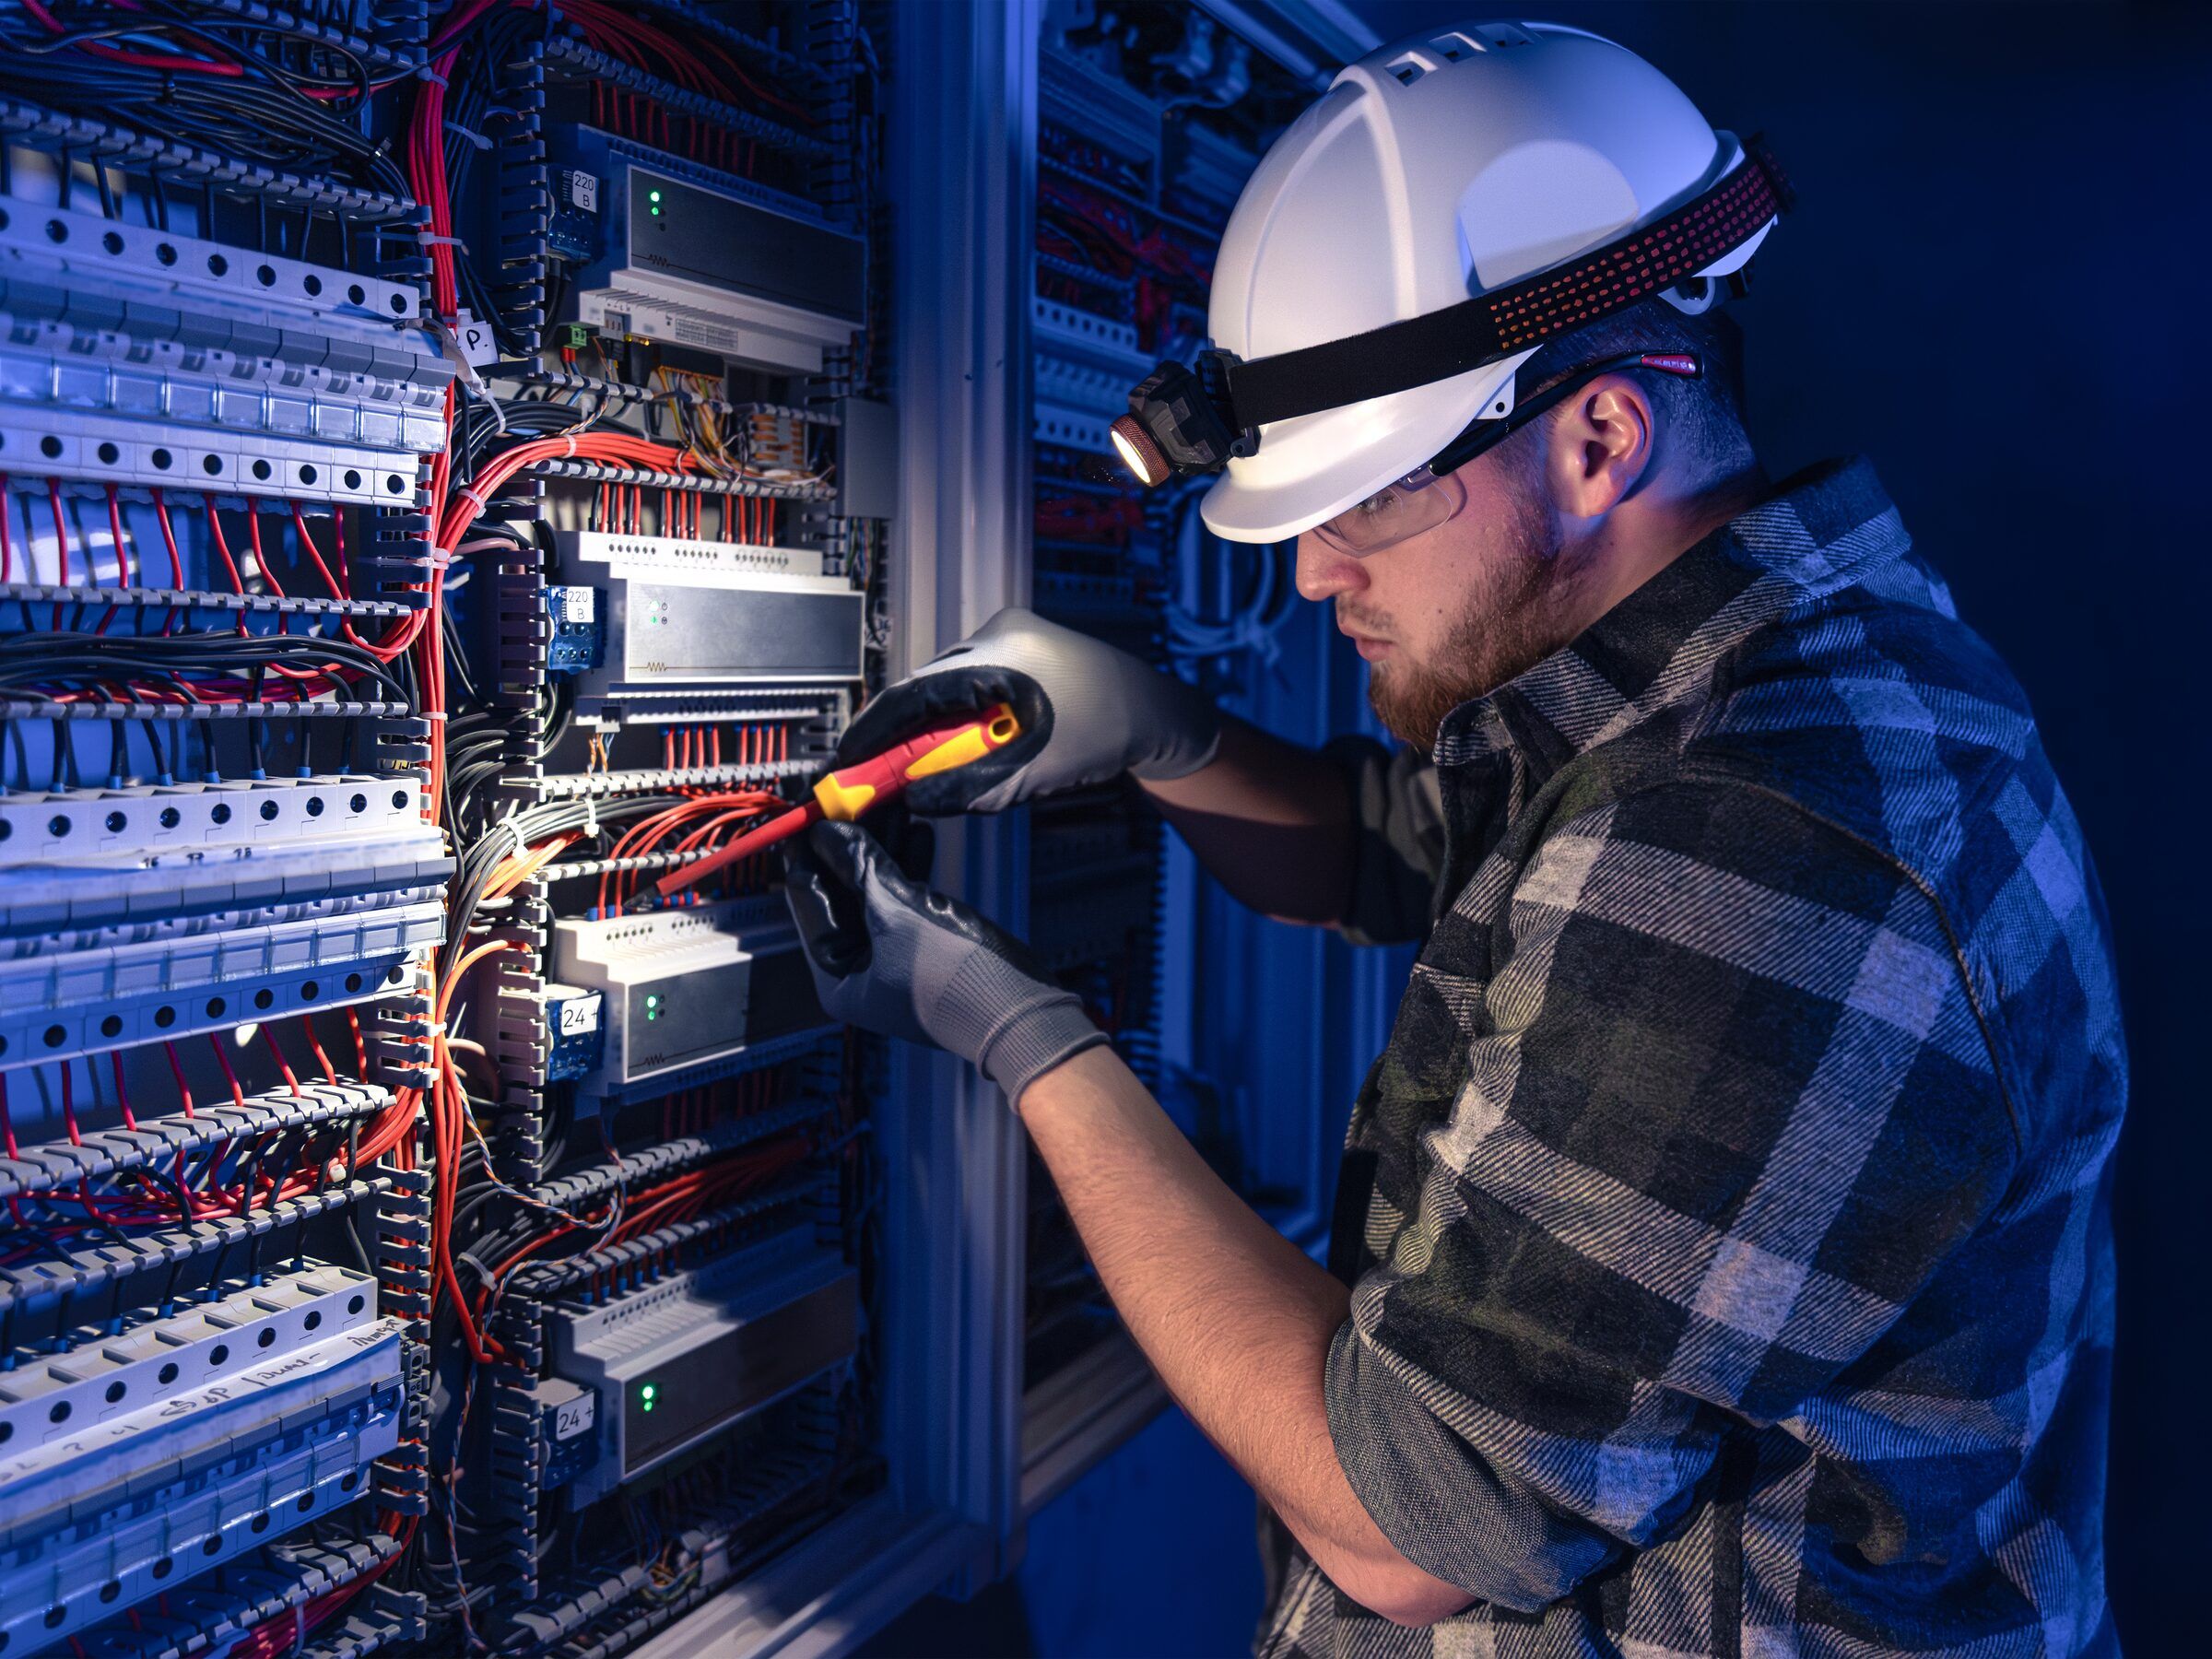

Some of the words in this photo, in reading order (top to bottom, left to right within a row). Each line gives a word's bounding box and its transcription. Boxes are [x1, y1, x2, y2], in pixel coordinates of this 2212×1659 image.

[574, 173, 594, 192] 220
[582, 194, 590, 207] B
[568, 591, 588, 603] 220
[577, 607, 585, 620] B
[563, 1007, 585, 1028] 24
[559, 1407, 581, 1434] 24
